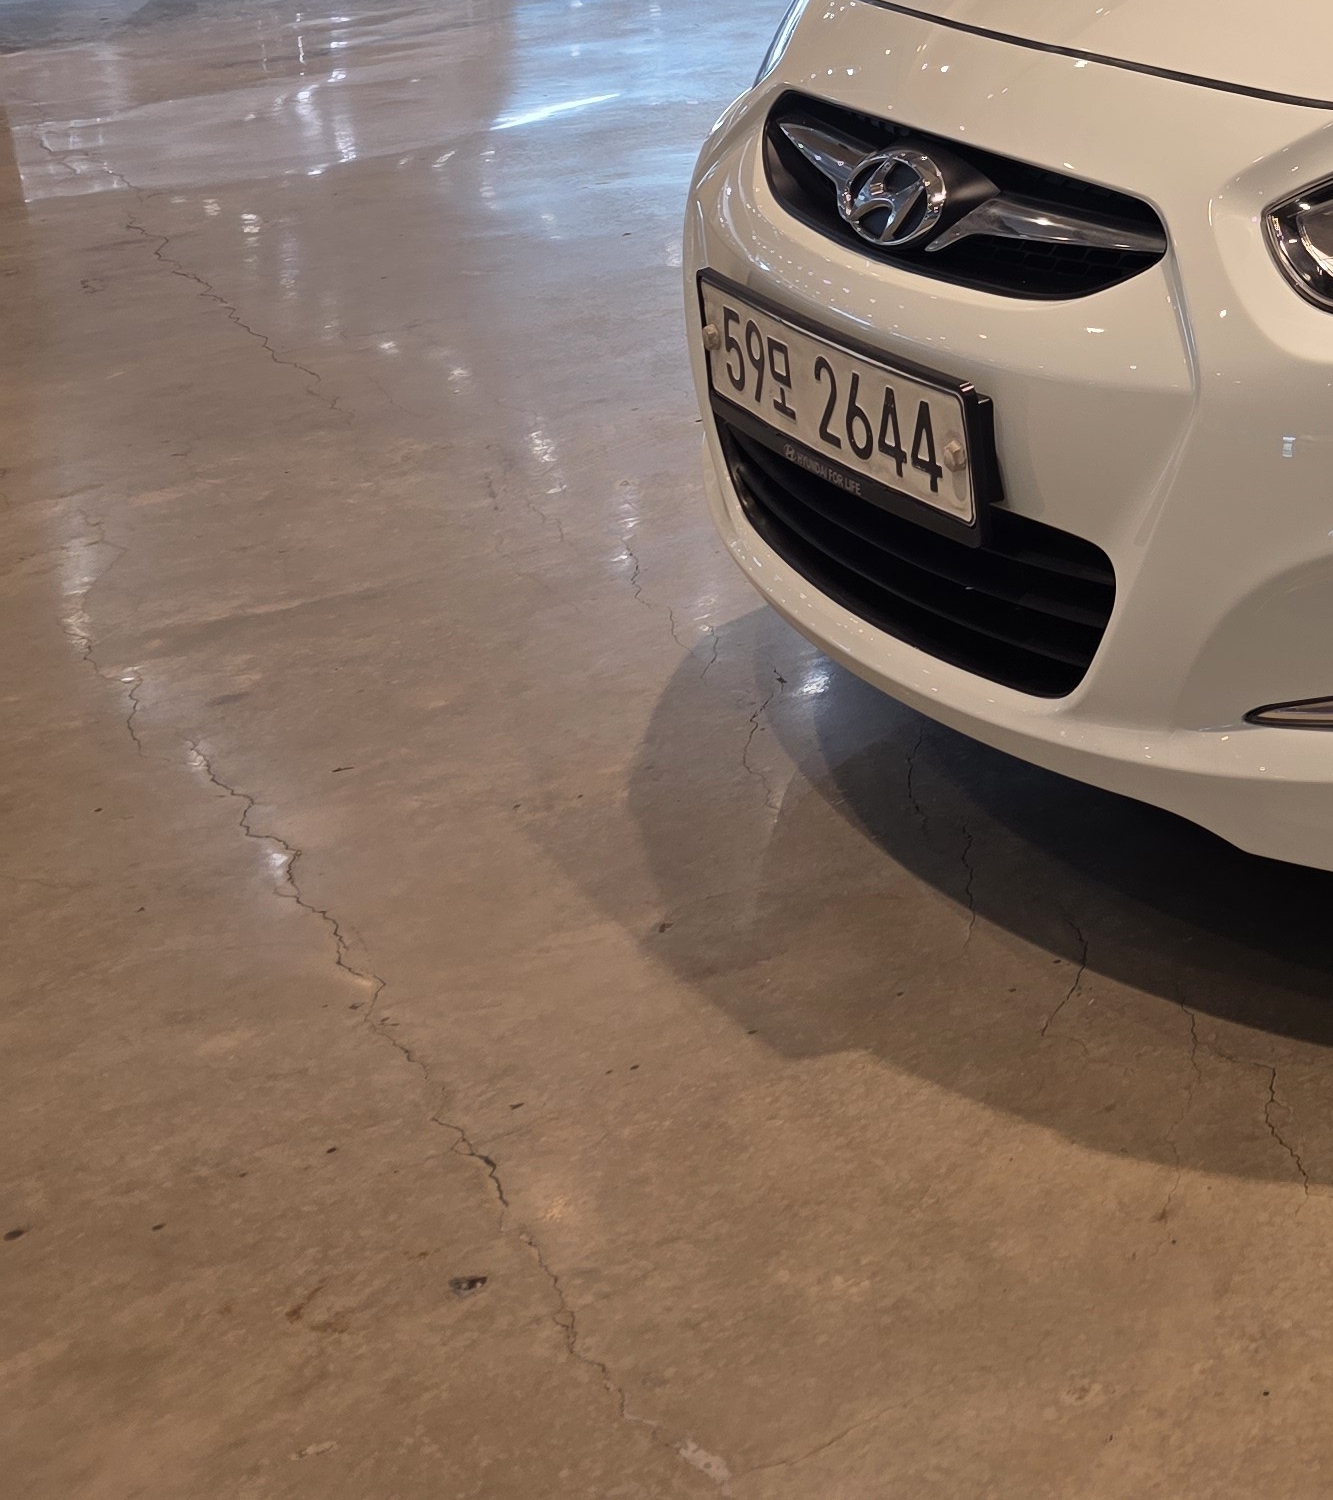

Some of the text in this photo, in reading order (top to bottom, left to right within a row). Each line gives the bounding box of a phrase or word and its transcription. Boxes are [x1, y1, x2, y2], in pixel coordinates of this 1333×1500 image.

[723, 304, 943, 493] 59모 2644
[828, 468, 844, 487] FOR
[844, 477, 862, 497] LIFE
